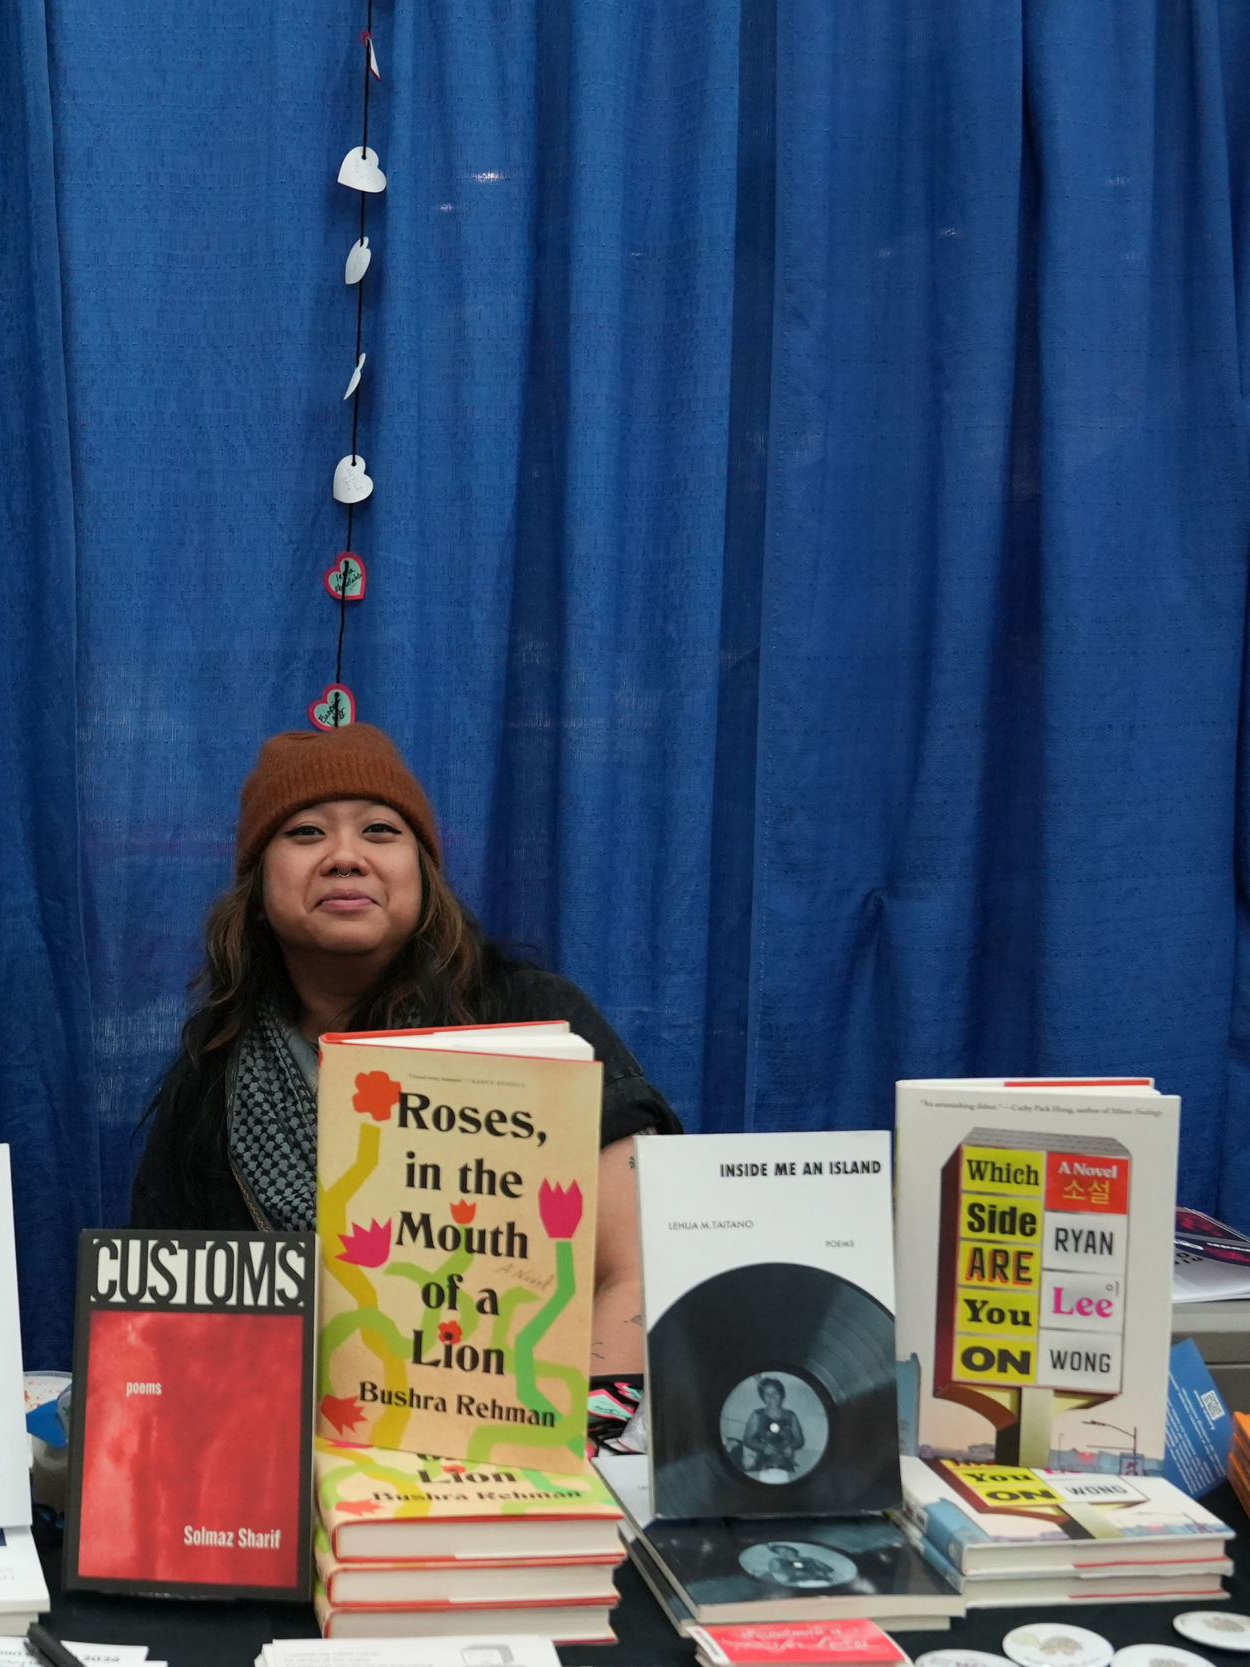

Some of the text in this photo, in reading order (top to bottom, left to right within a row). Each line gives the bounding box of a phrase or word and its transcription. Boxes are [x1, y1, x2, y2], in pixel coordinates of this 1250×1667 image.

[396, 1091, 548, 1147] Roses,
[405, 1151, 524, 1199] in the
[720, 1160, 882, 1178] INSIDE ME AN ISLAND
[966, 1159, 1040, 1186] Which
[1058, 1162, 1118, 1180] A Novel
[1062, 1179, 1111, 1206] 소설
[668, 1220, 699, 1231] LEHUA
[711, 1219, 754, 1230] TAITANO
[967, 1202, 1038, 1237] Side
[395, 1210, 529, 1259] Mouth
[825, 1239, 855, 1248] POEMS
[1054, 1227, 1114, 1257] RYAN
[91, 1238, 306, 1308] CUSTOMS
[965, 1247, 1034, 1286] ARE
[421, 1273, 500, 1316] of a
[1052, 1286, 1114, 1318] Lee
[1105, 1281, 1120, 1298] 이
[964, 1299, 1033, 1327] You
[411, 1328, 505, 1375] Lion
[961, 1346, 1032, 1375] ON
[1051, 1349, 1112, 1374] WONG
[126, 1380, 163, 1397] poems
[358, 1381, 555, 1429] Bushra Rehman
[417, 1467, 517, 1485] Lion
[964, 1471, 1035, 1484] You
[372, 1489, 582, 1502] Bushra Rehman
[986, 1488, 1058, 1501] ON
[1065, 1484, 1129, 1497] WONG
[183, 1525, 282, 1550] Solmaz Sharif
